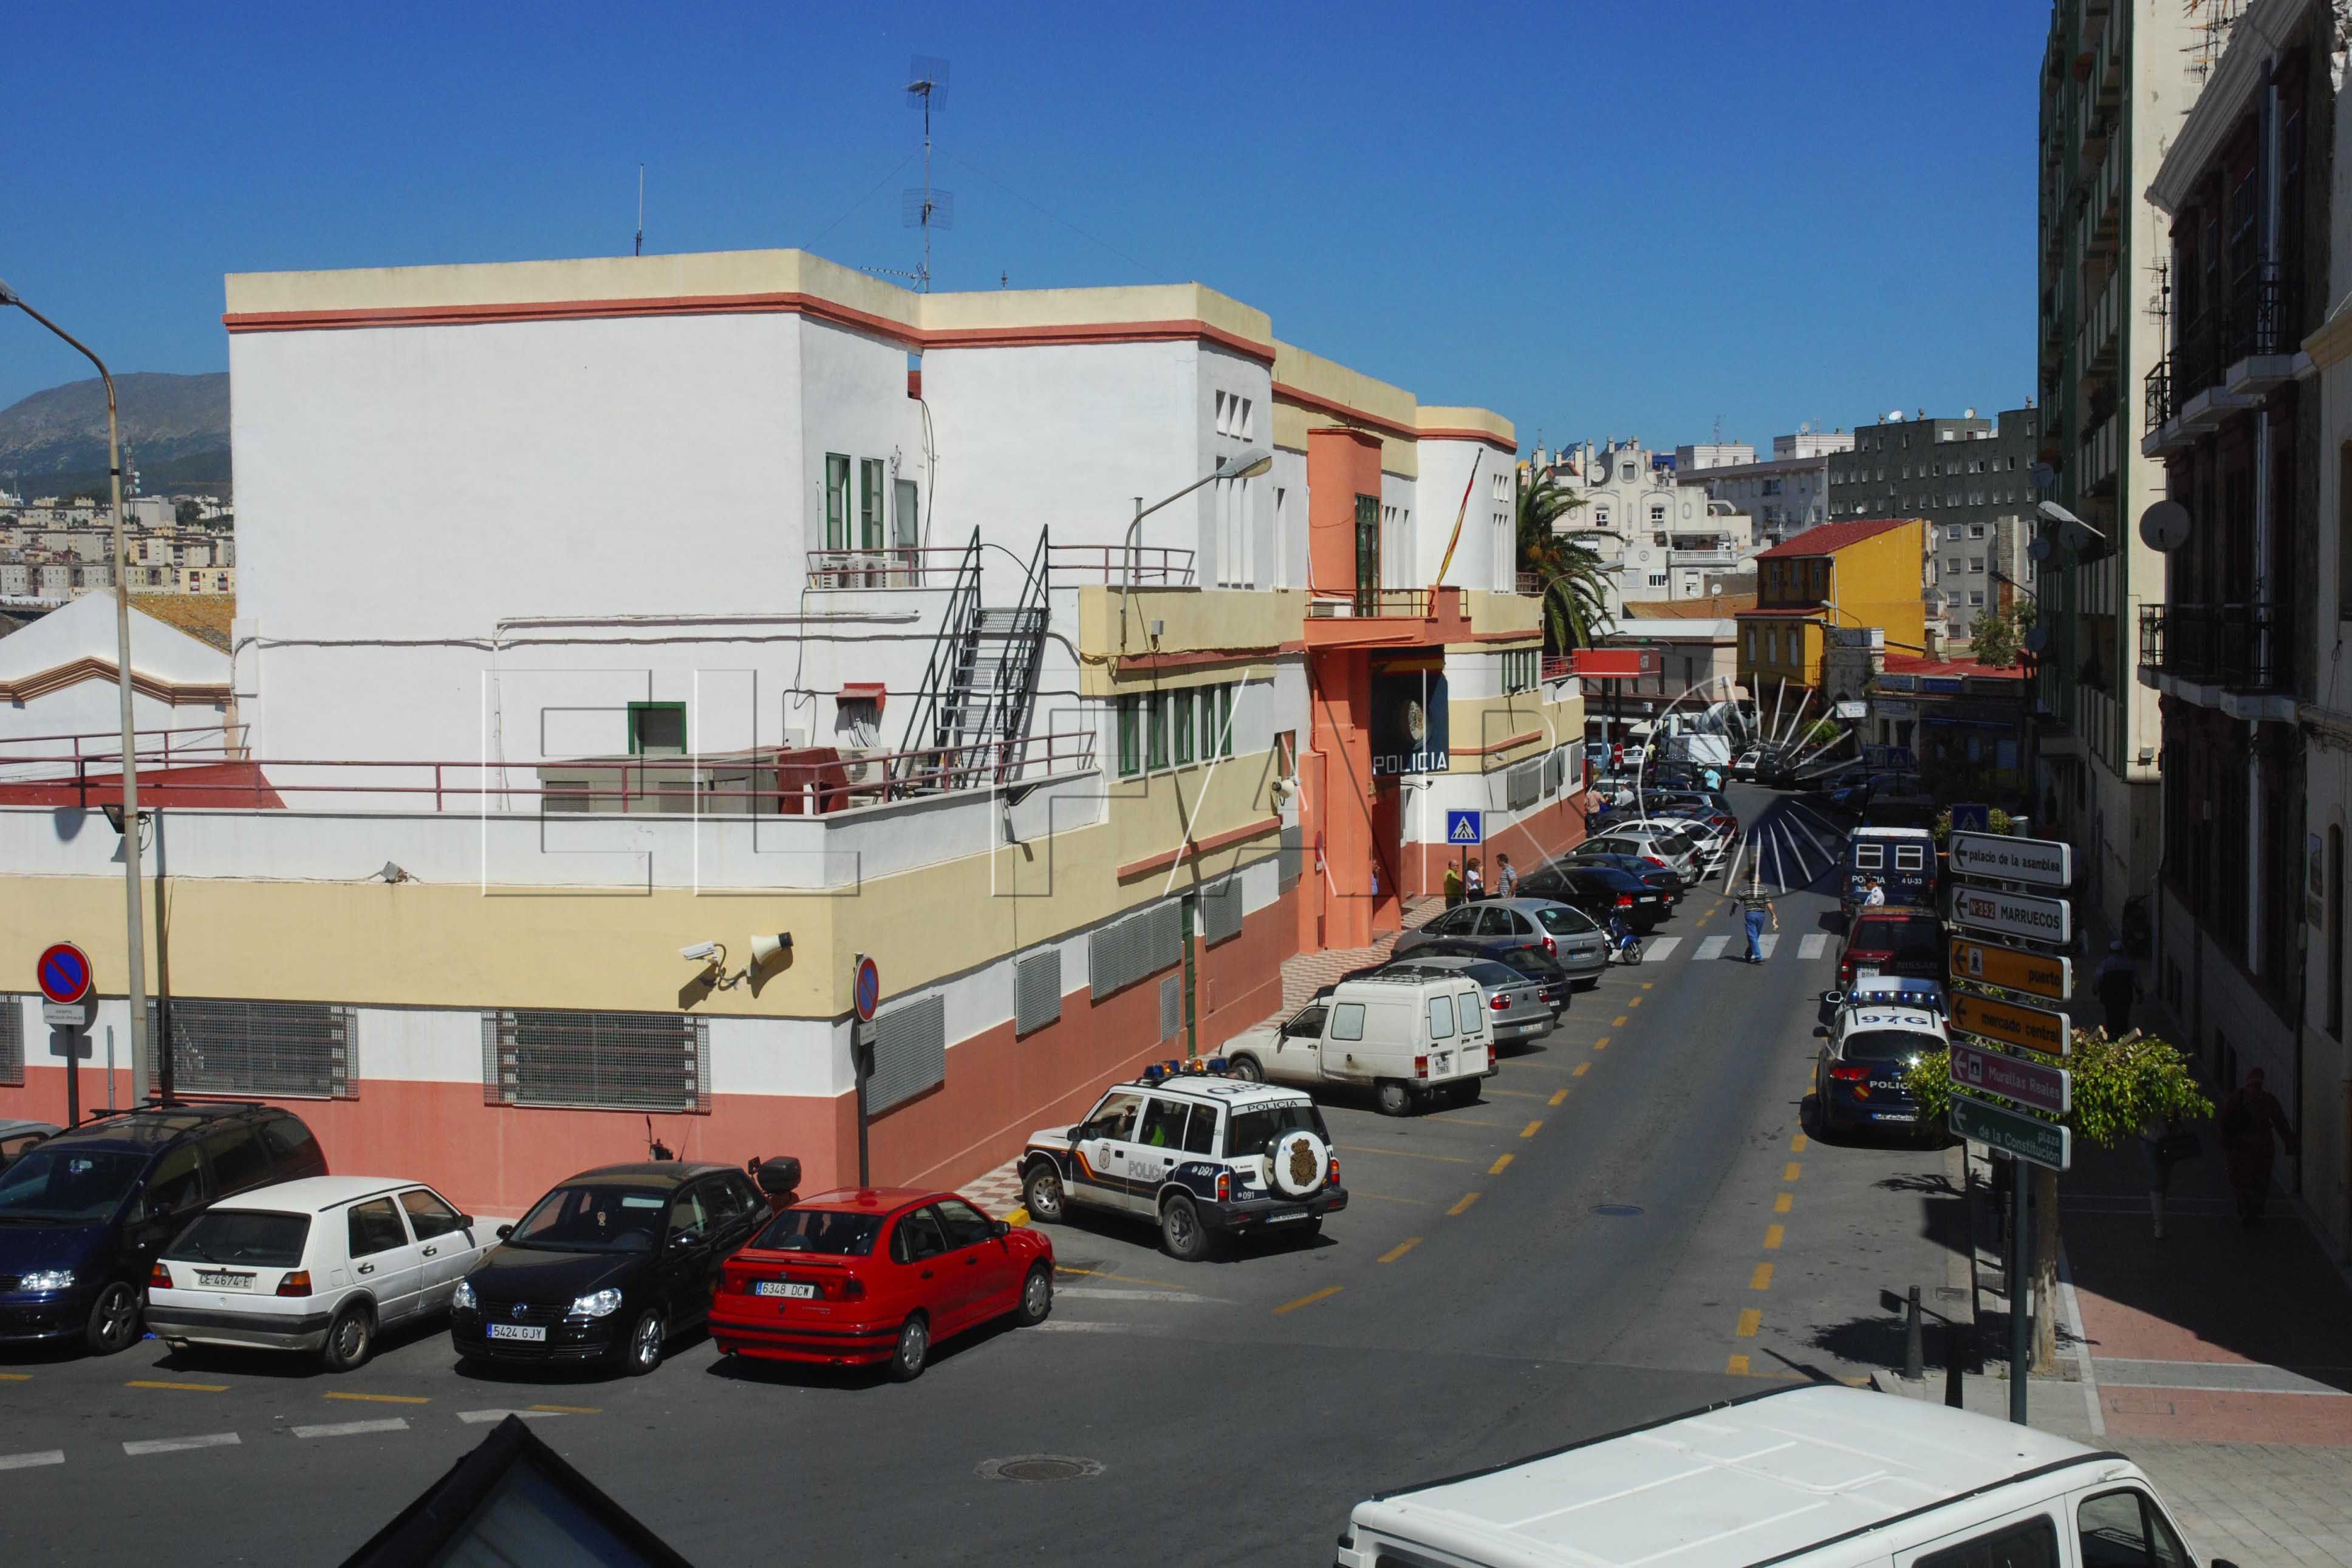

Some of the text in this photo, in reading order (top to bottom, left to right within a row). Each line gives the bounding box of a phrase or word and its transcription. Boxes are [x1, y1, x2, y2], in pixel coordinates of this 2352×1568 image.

[1373, 751, 1448, 775] POLICIA
[1969, 850, 2060, 872] palacio de la asamblea
[1969, 899, 2060, 930] N-352 MARRUECOS
[2028, 969, 2061, 987] puerto
[1861, 1015, 1928, 1025] 97G
[1981, 1013, 2061, 1043] mercado central
[1988, 1065, 2060, 1100] Murallas Reales
[1247, 1100, 1298, 1112] POLICIA
[1979, 1125, 2060, 1164] de la Constitución
[2037, 1131, 2060, 1147] plaza
[1242, 1191, 1255, 1199] 091
[200, 1273, 249, 1287] CE-4674-E
[762, 1283, 810, 1297] 6348 DCW
[494, 1326, 542, 1340] 5424 GJY
